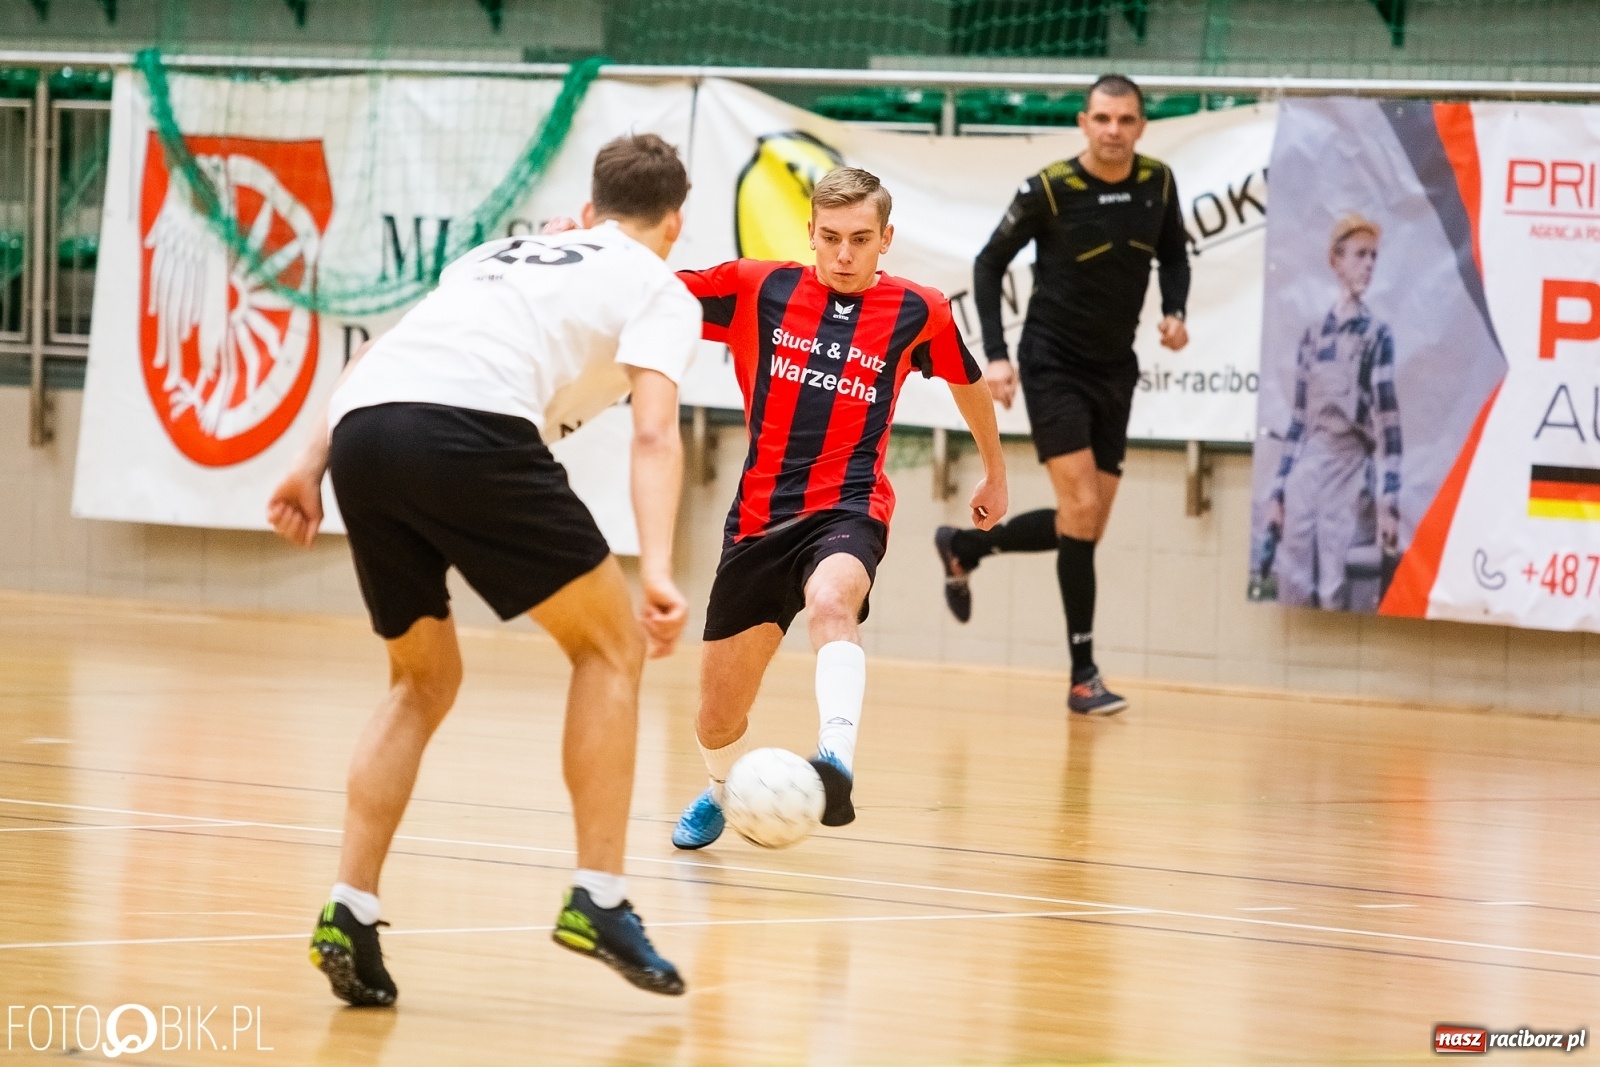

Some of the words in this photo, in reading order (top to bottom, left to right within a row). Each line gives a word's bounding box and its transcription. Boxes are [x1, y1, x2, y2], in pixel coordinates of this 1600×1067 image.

[771, 328, 824, 355] Stuck
[826, 342, 841, 360] &
[846, 346, 887, 374] Putz
[769, 354, 878, 403] Warzecha
